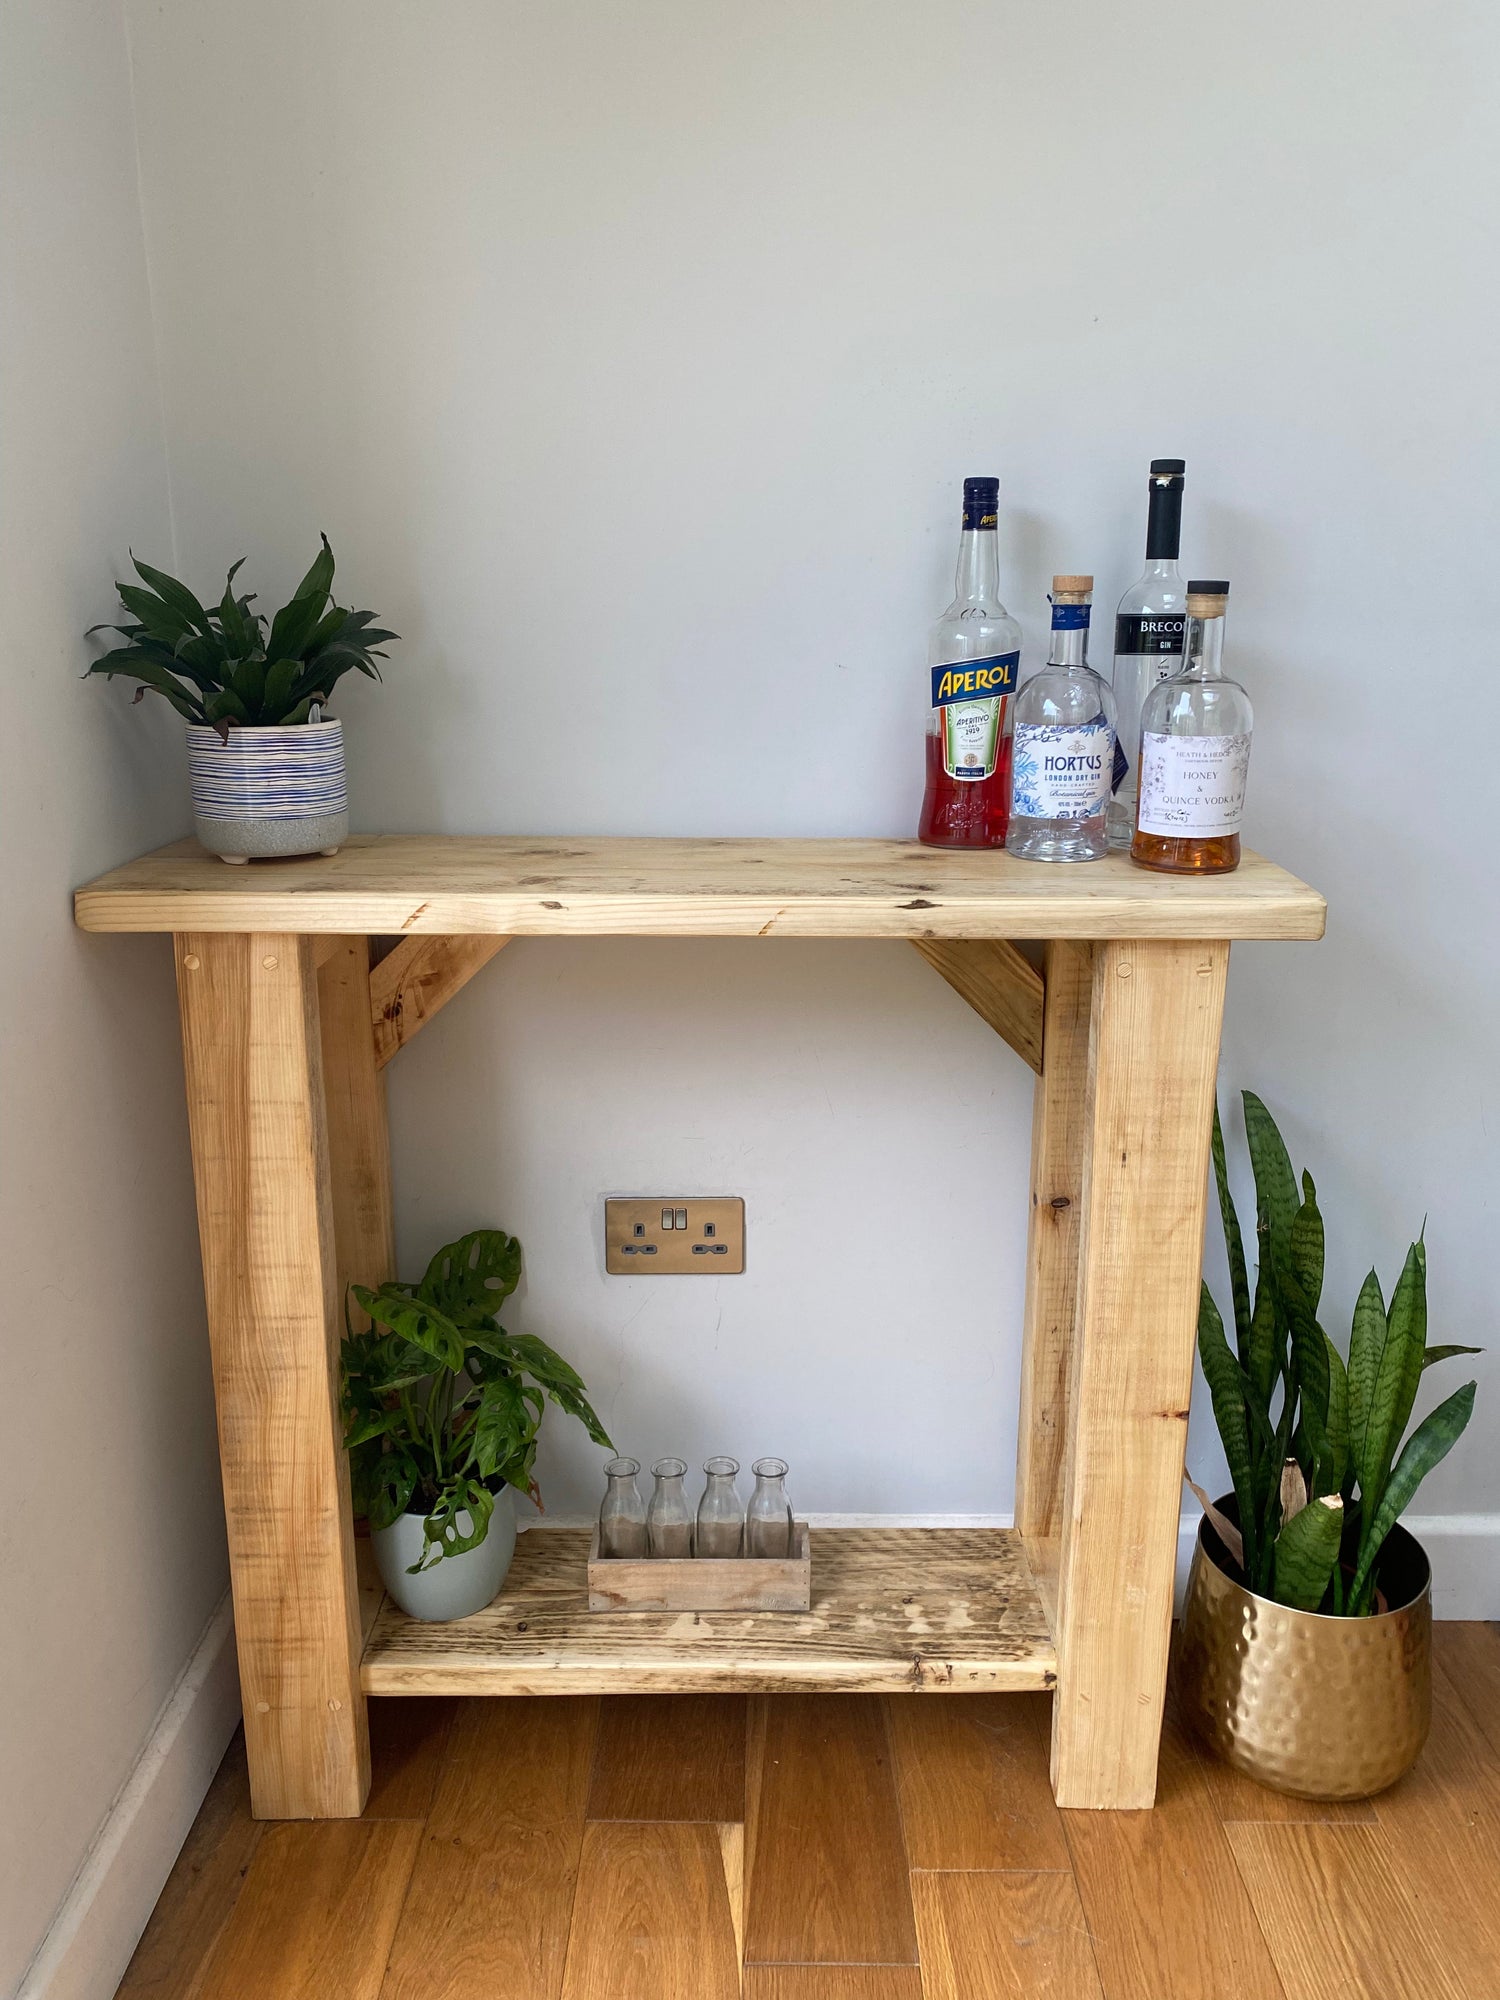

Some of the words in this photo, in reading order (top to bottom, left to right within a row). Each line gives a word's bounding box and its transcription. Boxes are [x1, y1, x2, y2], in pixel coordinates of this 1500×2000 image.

[1159, 641, 1171, 649] GIN
[938, 664, 1011, 699] APEROL
[956, 714, 990, 726] APERITIVO
[1044, 755, 1102, 771] HORTUS
[1183, 771, 1218, 780] HONEY
[1162, 796, 1201, 806] QUINCE
[1205, 796, 1235, 805] VODKA
